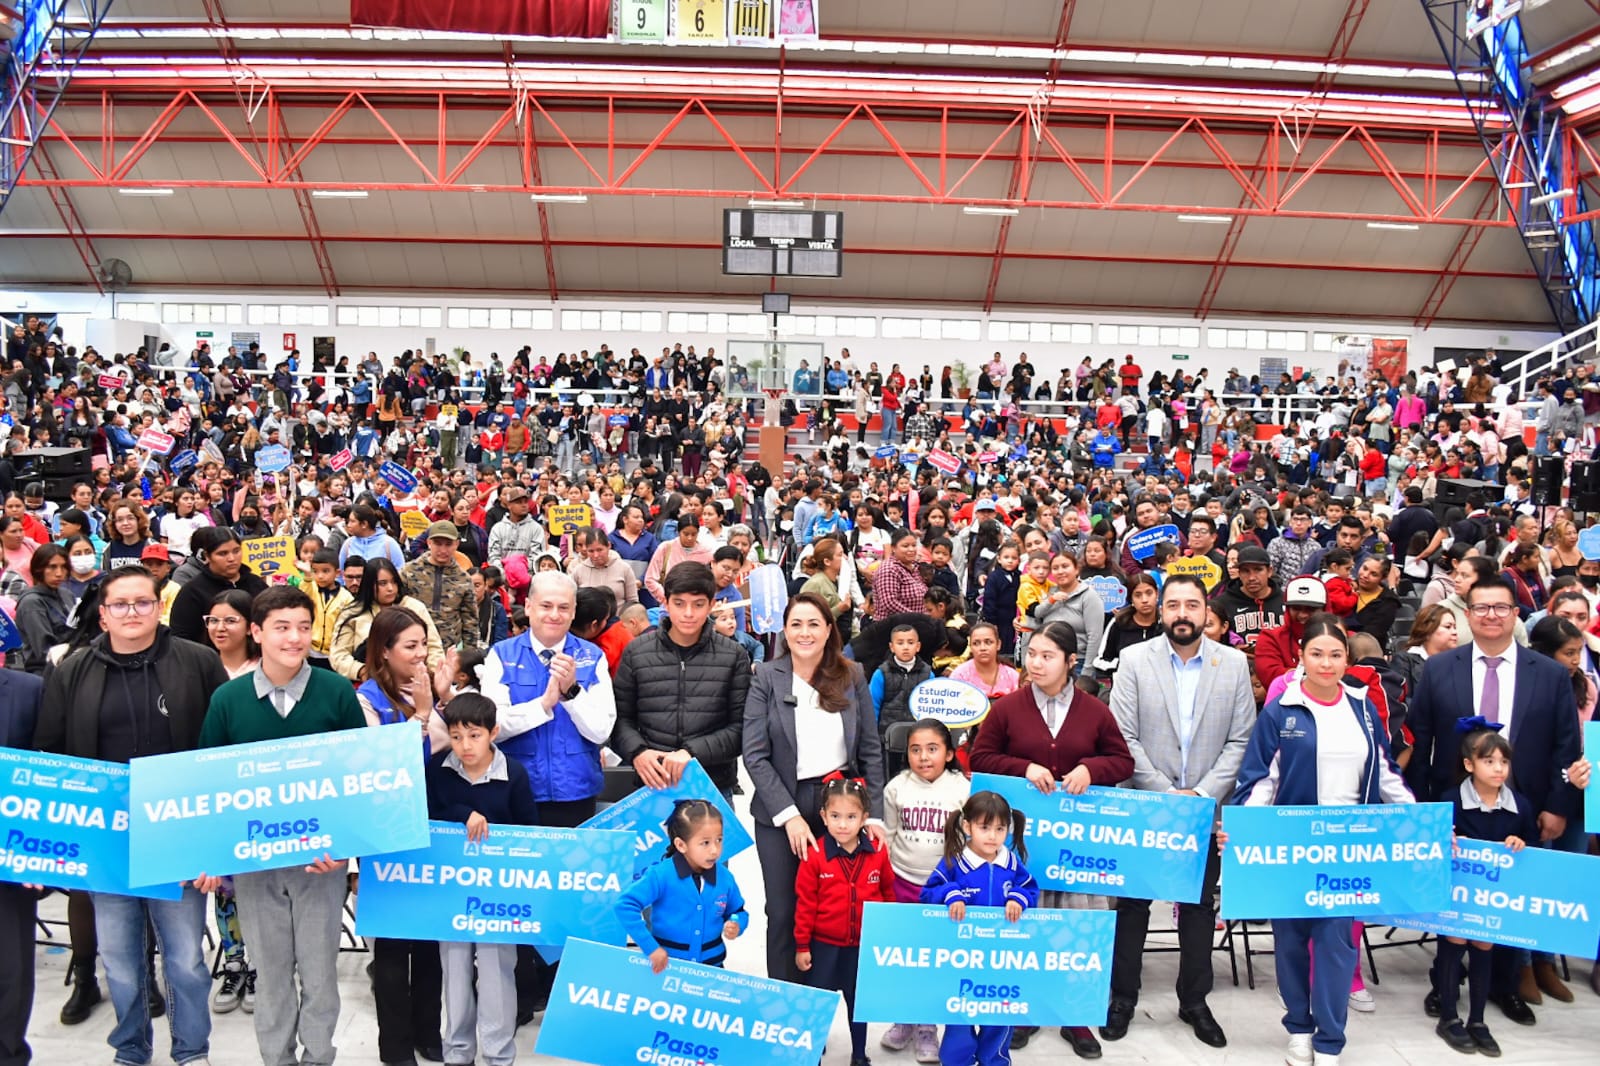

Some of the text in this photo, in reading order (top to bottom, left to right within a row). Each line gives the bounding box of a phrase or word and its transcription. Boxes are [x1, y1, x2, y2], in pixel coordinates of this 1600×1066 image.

[637, 8, 646, 29] 9
[695, 9, 704, 32] 6
[730, 240, 756, 248] LOCAL
[808, 241, 834, 250] VISITA
[555, 514, 584, 523] policía
[246, 539, 286, 551] Yo seré
[248, 548, 286, 562] policía
[1188, 564, 1208, 572] seré
[920, 686, 960, 698] Estudiar
[918, 706, 977, 716] superpoder
[144, 794, 210, 822] VALE
[216, 786, 272, 814] POR
[279, 778, 338, 806] UNA
[343, 768, 414, 796] BECA
[0, 795, 41, 820] OR
[47, 801, 106, 829] UNA
[247, 818, 320, 840] Pasos
[1037, 820, 1084, 842] POR
[1089, 826, 1138, 846] UNA
[1142, 830, 1198, 852] BECA
[7, 829, 80, 858] Pasos
[234, 834, 332, 861] Gigantes
[1234, 842, 1444, 864] VALE POR UNA BECA
[1059, 849, 1118, 871] Pasos
[373, 862, 622, 892] VALE POR UNA BECA
[1046, 864, 1125, 887] Gigantes
[1316, 873, 1372, 891] Pasos
[466, 896, 532, 917] Pasos
[1305, 890, 1380, 910] Gigantes
[1474, 888, 1524, 912] POR
[1530, 896, 1589, 922] VALE
[452, 914, 541, 936] Gigantes
[873, 946, 1102, 972] VALE POR UNA BECA
[959, 978, 1020, 998] Pasos
[568, 983, 813, 1050] VALE POR UNA BECA
[946, 997, 1028, 1018] Gigantes
[652, 1030, 719, 1060] Pasos
